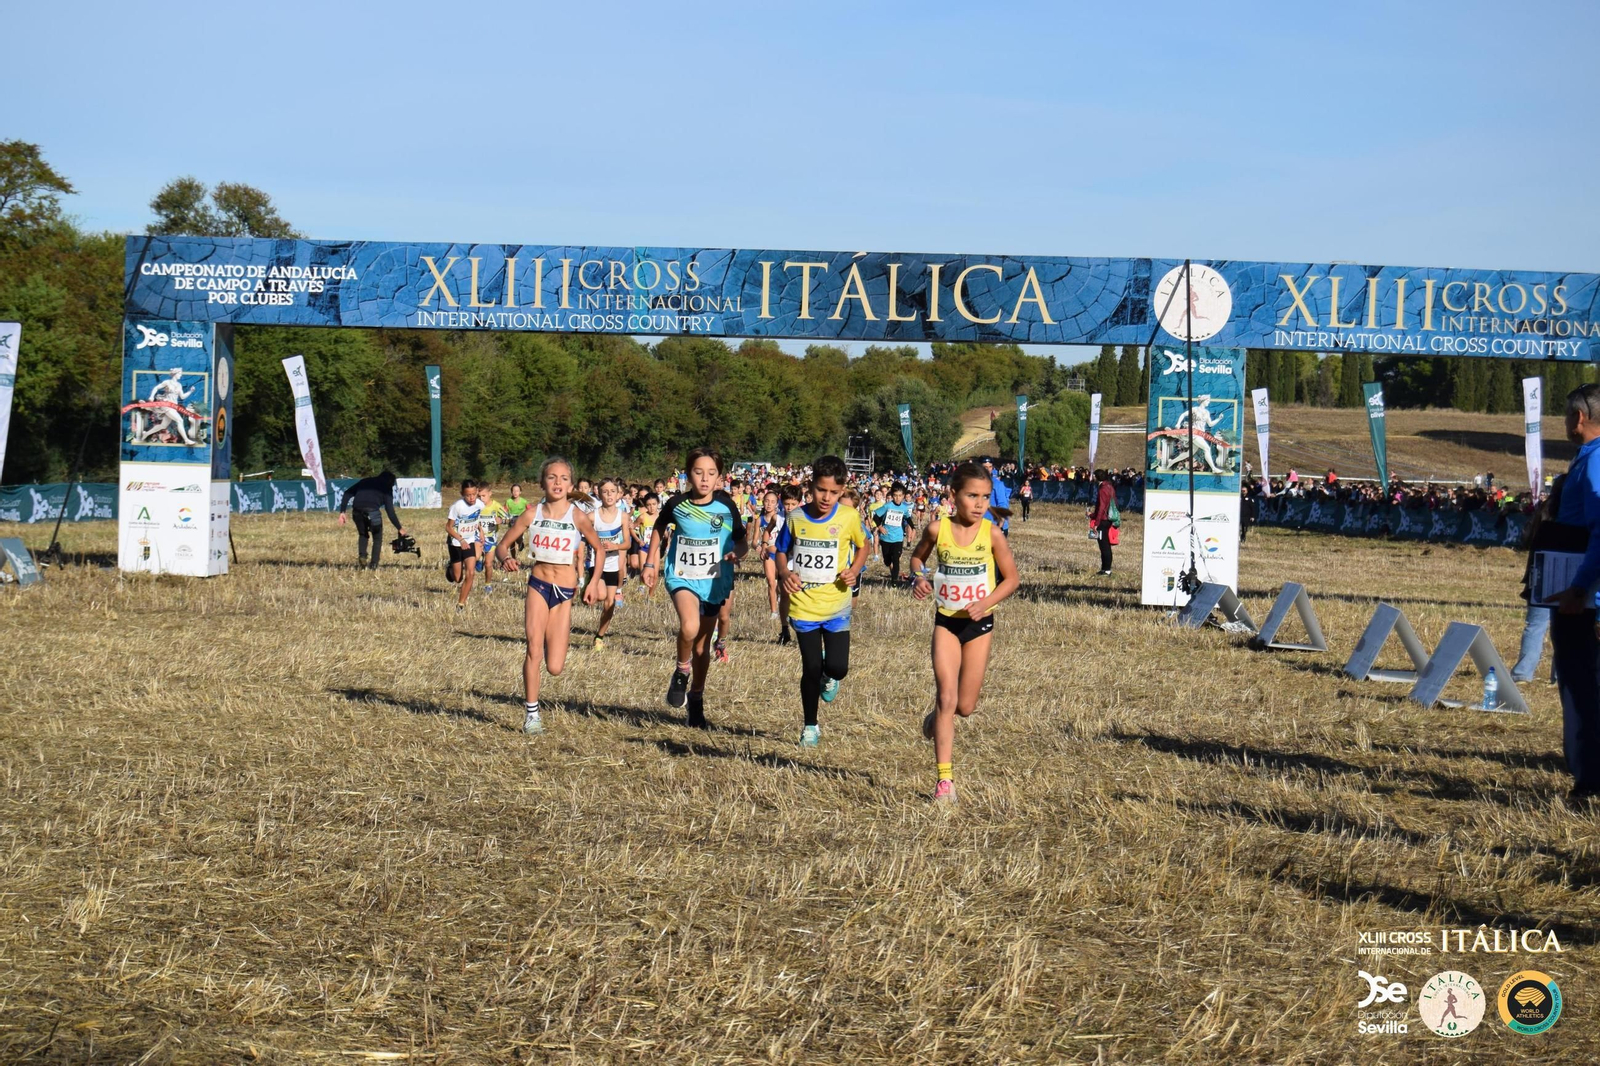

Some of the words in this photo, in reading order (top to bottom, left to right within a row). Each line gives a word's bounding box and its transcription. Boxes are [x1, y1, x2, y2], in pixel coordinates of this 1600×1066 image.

[141, 263, 245, 278] CAMPEONATO
[246, 265, 266, 278] DE
[268, 264, 358, 280] ANDALUCÍA
[174, 278, 194, 290] DE
[196, 279, 251, 291] CAMPO
[253, 279, 266, 292] A
[268, 275, 324, 293] TRAVÉS
[417, 256, 577, 309] XLIII
[578, 260, 702, 291] CROSS
[757, 252, 1058, 325] ITÁLICA
[207, 291, 238, 304] POR
[239, 292, 294, 306] CLUBES
[579, 294, 745, 313] INTERNACIONAL
[1274, 274, 1438, 330] XLIII
[1441, 282, 1568, 316] CROSS
[417, 311, 564, 330] INTERNATIONAL
[568, 315, 624, 330] CROSS
[627, 315, 715, 332] COUNTRY
[170, 338, 203, 348] Sevilla
[1273, 331, 1428, 351] INTERNATIONAL
[1430, 335, 1488, 353] CROSS
[1491, 339, 1582, 357] COUNTRY
[1198, 364, 1232, 375] Sevilla
[532, 533, 571, 551] 4442
[679, 551, 717, 567] 4151
[795, 553, 834, 569] 4282
[938, 583, 986, 602] 4346
